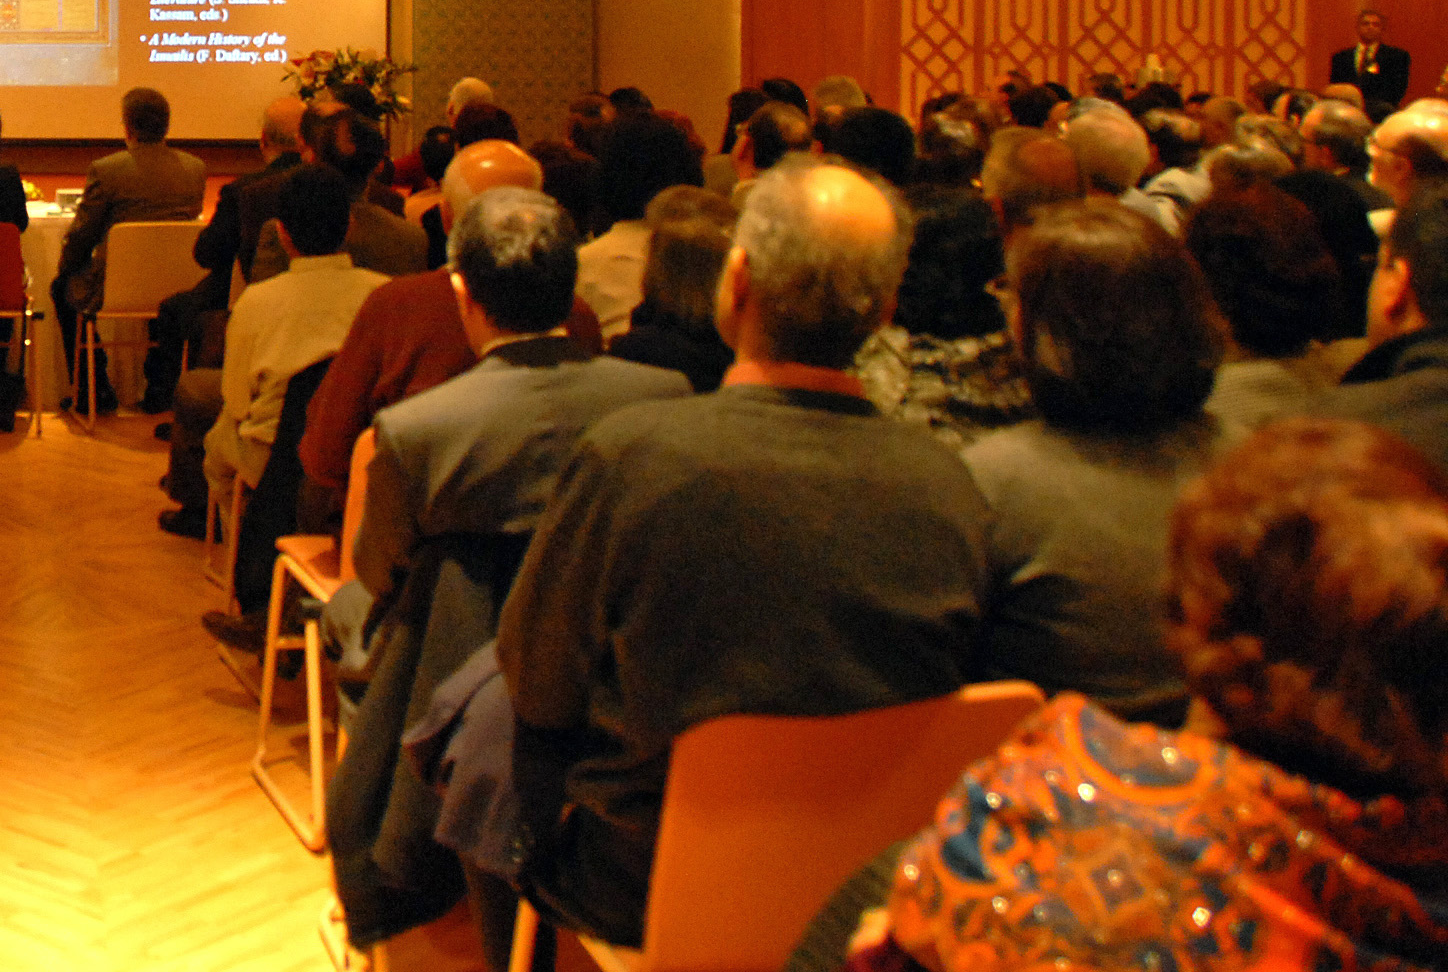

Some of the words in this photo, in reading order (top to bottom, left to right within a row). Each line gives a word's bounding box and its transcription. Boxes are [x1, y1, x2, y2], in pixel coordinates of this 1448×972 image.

[149, 33, 159, 45] A
[161, 33, 206, 45] Modern
[208, 33, 251, 46] History
[253, 33, 267, 47] of
[268, 33, 286, 45] the
[196, 50, 213, 62] (F.
